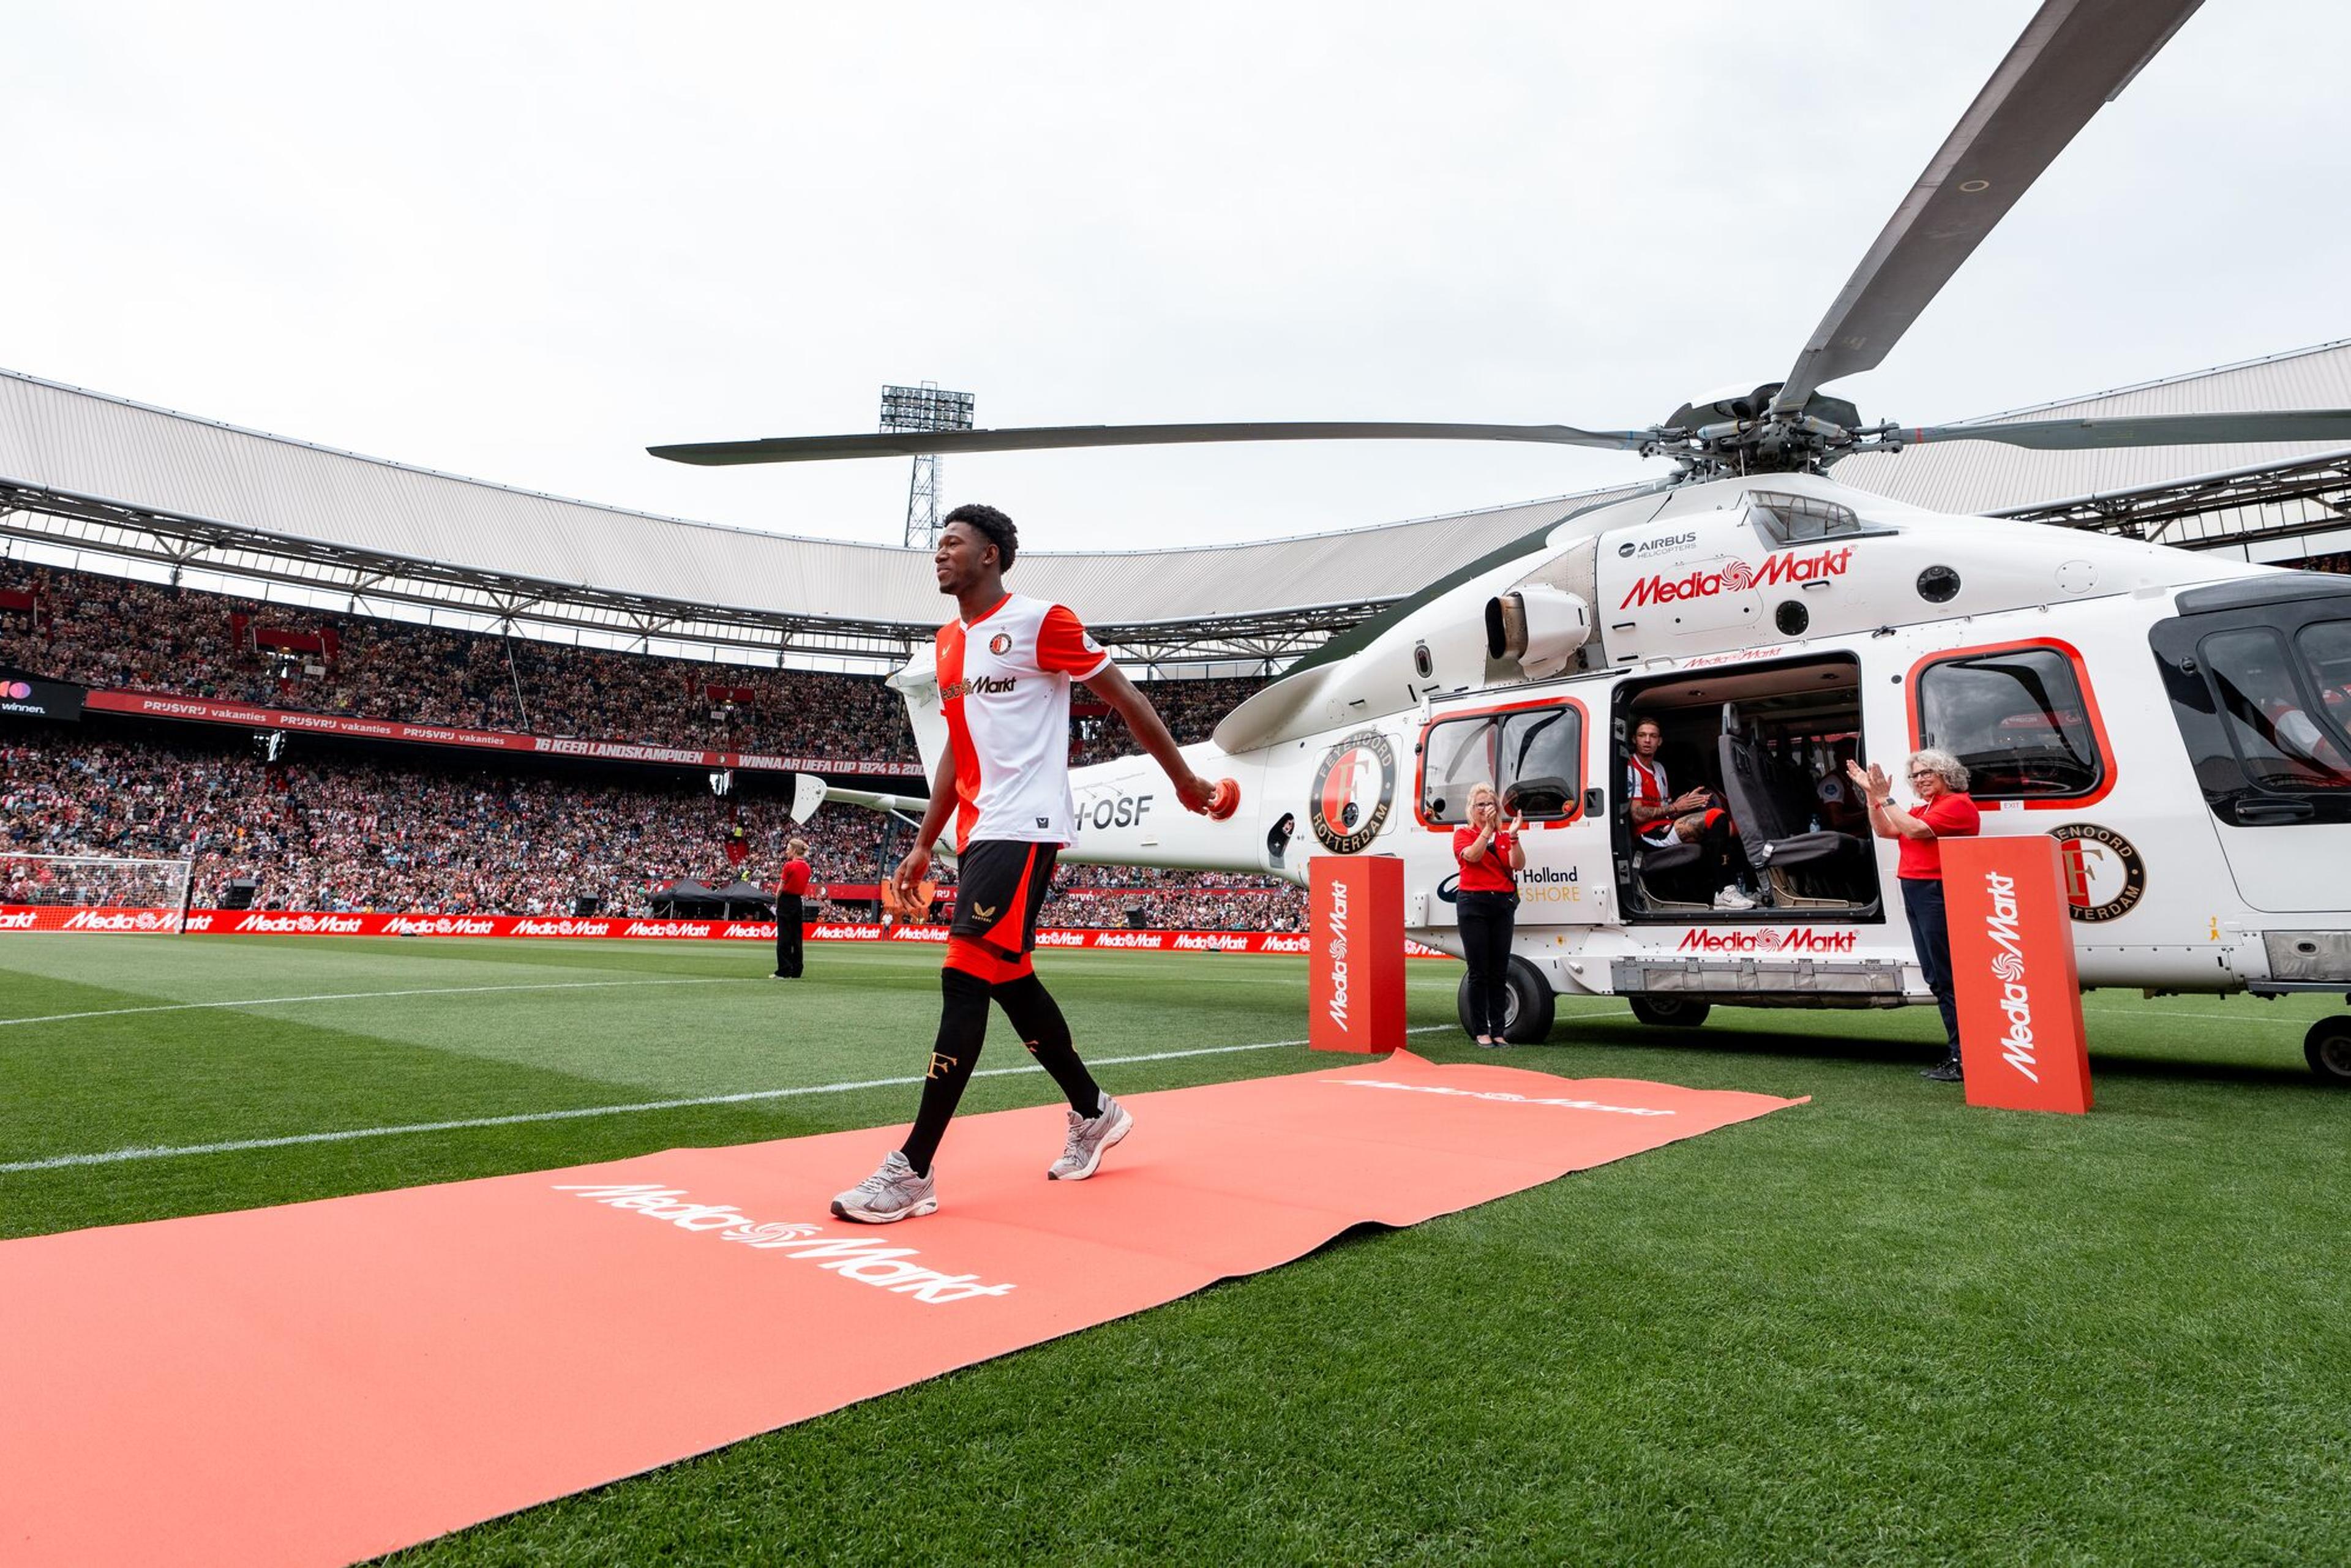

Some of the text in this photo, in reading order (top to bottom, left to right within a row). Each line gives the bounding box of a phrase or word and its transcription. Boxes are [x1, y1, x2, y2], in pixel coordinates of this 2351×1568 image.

[1638, 531, 1696, 552] AIRBUS
[1637, 542, 1697, 559] HELICOPTERS
[1619, 547, 1852, 610] Media Markt
[972, 677, 1016, 693] Markt
[2, 702, 46, 714] winnen.
[211, 708, 266, 722] vakanties
[341, 722, 391, 735] vakanties
[459, 734, 505, 746] vakanties
[534, 737, 704, 763] 16 KEER LANDSKAMPIOEN
[1319, 733, 1392, 778] FEYENOORD
[738, 754, 800, 770] WINNAAR
[803, 759, 832, 773] UEFA
[834, 761, 856, 773] CUP
[858, 762, 887, 774] 1974
[902, 764, 926, 775] 200
[1313, 803, 1387, 852] ROTTERDAM
[2057, 827, 2132, 857] ENOORD
[1523, 866, 1578, 883] Holland
[2072, 885, 2140, 920] TERDAM
[0, 910, 37, 928] arkt
[63, 910, 135, 929] Media
[235, 914, 362, 932] Media Markt
[381, 917, 494, 935] Media Markt
[510, 920, 609, 936] Media Markt
[624, 922, 710, 937] Media Markt
[723, 924, 762, 937] Media
[811, 926, 880, 939] Media Markt
[893, 928, 922, 940] Media
[1057, 932, 1085, 945] Markt
[1095, 933, 1162, 948] Media Markt
[1174, 934, 1248, 950] Media Markt
[1261, 936, 1300, 951] Media
[1677, 928, 1856, 953] Media Markt
[1329, 880, 1347, 1033] Media Markt
[1985, 871, 2039, 1084] Media Markt
[550, 1184, 1018, 1304] Media Markt
